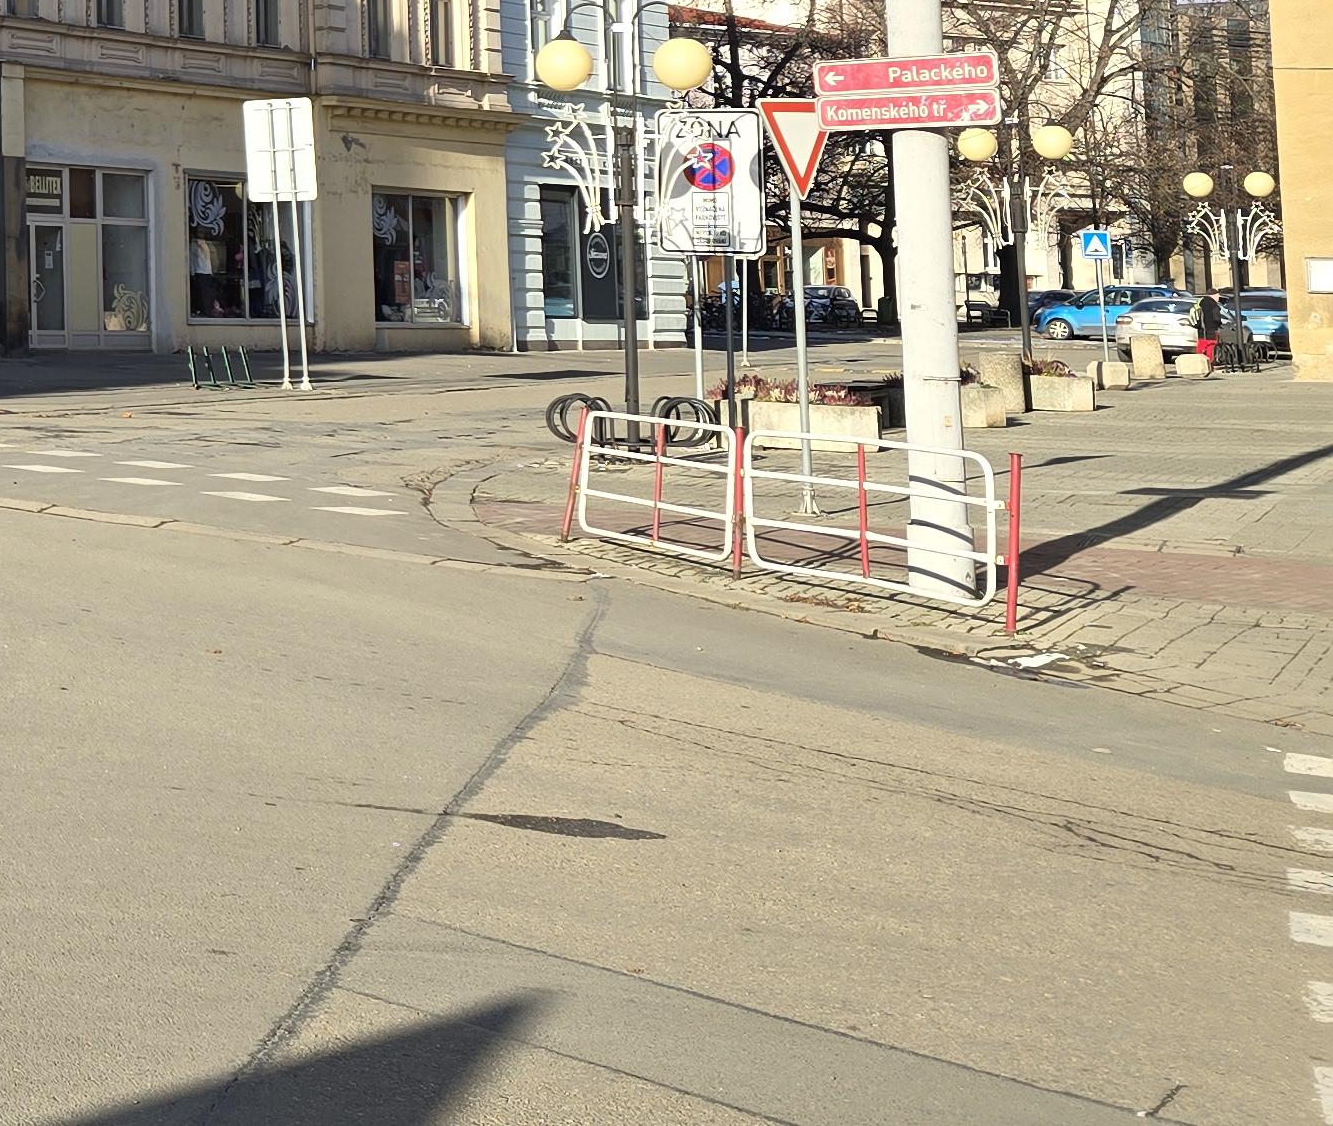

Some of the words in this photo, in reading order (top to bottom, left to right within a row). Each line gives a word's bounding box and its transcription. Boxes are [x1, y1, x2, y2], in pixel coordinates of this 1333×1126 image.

[887, 62, 988, 83] Palackého
[826, 101, 929, 122] Komenského
[29, 175, 62, 195] BELLITEX
